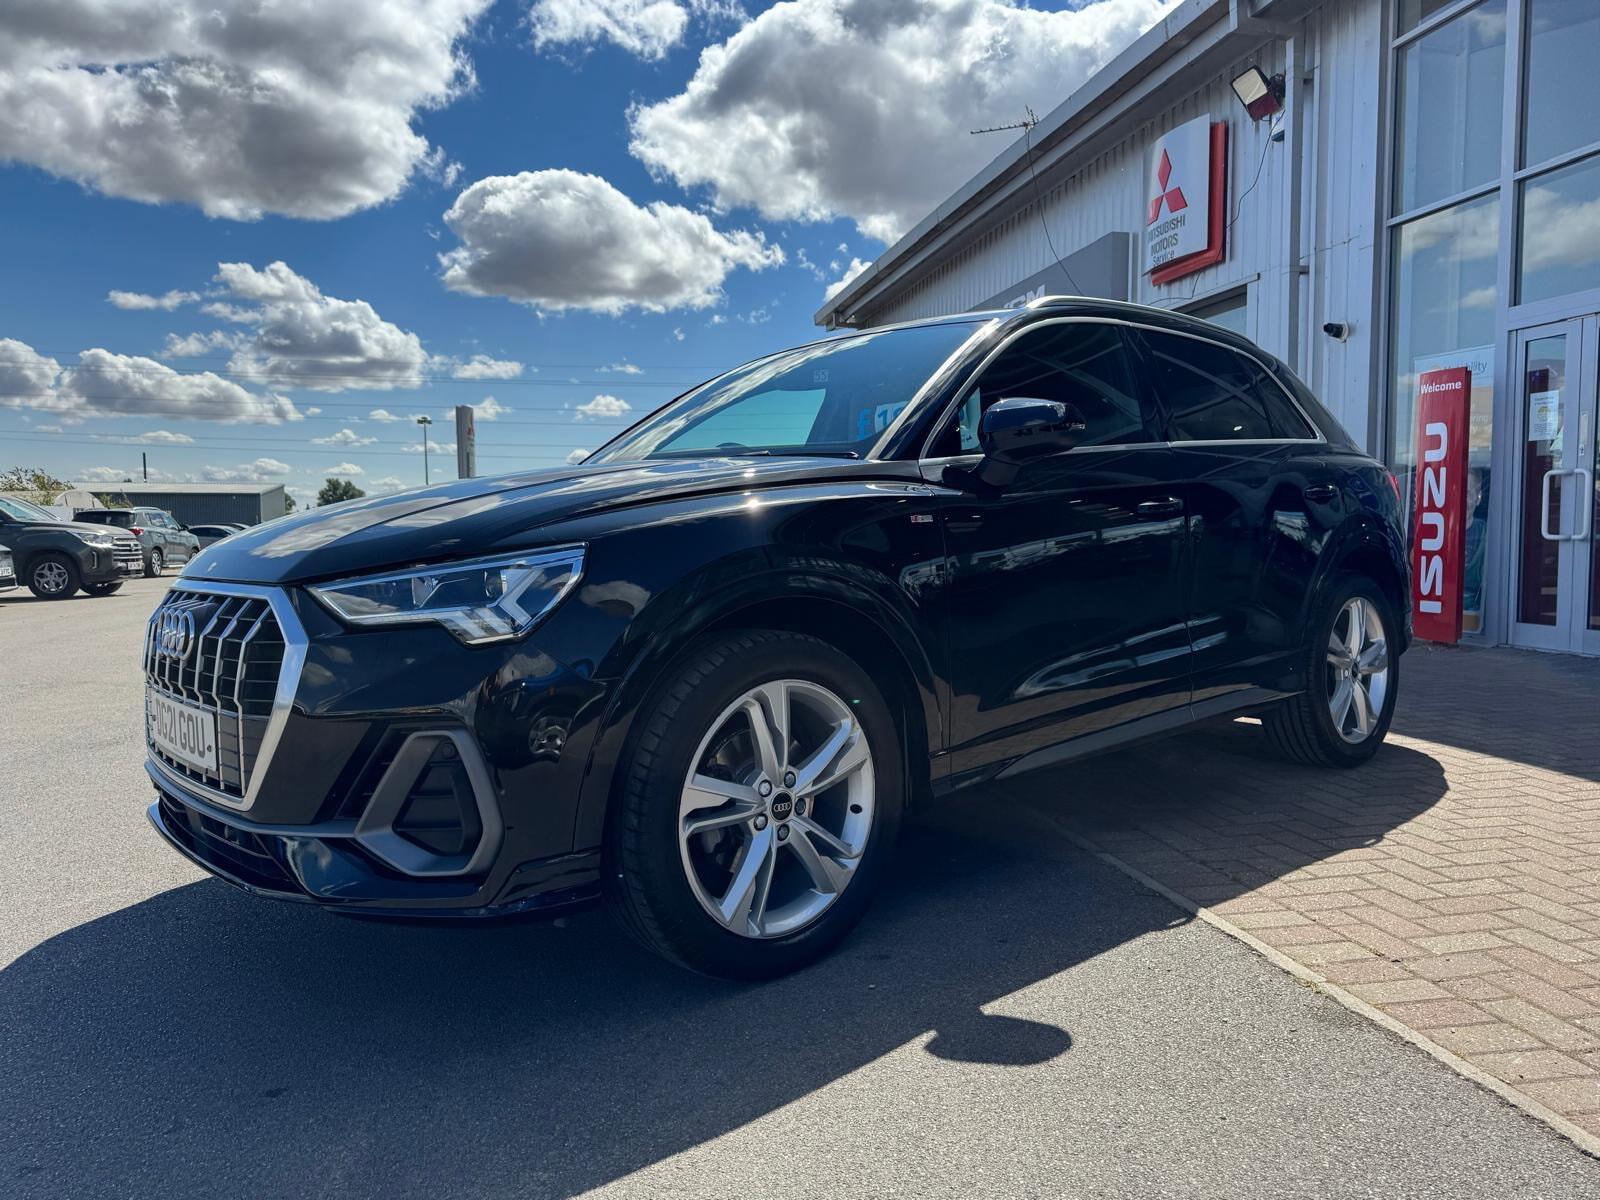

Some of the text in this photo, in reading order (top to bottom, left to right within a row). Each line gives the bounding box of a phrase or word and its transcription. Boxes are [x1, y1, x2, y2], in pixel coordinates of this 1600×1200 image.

[1151, 232, 1178, 256] MOTORS
[1153, 250, 1175, 266] Service
[1420, 381, 1462, 394] Welcome
[1419, 422, 1448, 614] ISUZU
[179, 710, 206, 759] GOU
